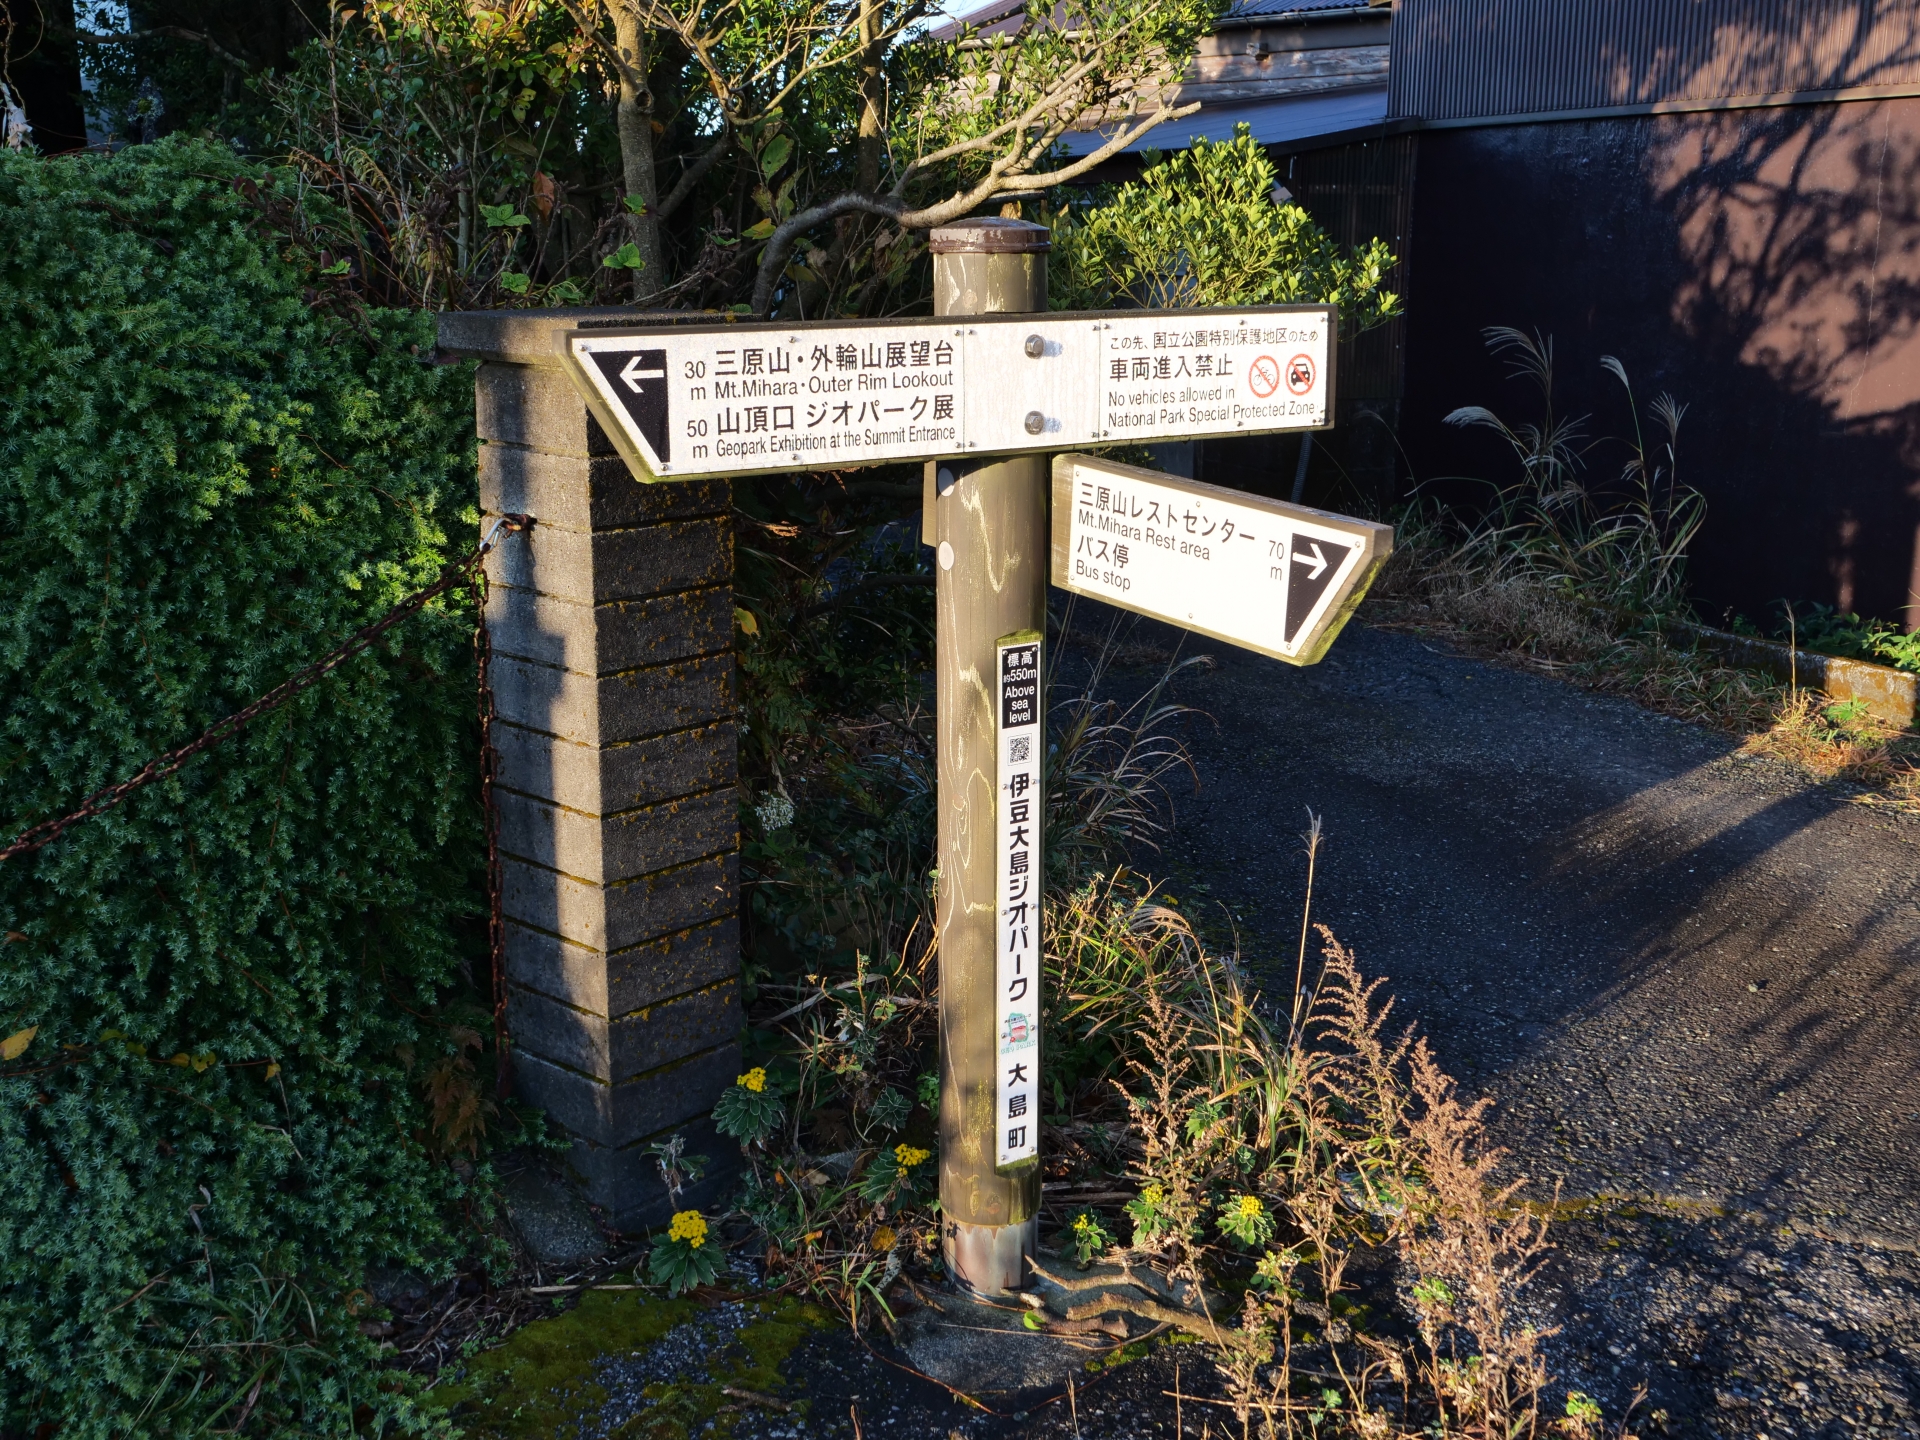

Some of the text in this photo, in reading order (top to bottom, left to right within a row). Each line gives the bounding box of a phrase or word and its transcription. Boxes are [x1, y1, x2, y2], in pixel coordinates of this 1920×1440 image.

[715, 340, 954, 376] 三原山・外輪山展望台
[1109, 353, 1233, 382] 車両進入禁止
[685, 361, 706, 379] 30
[858, 373, 887, 391] Rim
[892, 371, 953, 389] Lookout
[690, 386, 706, 400] m
[1109, 386, 1235, 407] No vehicles allowed in
[1108, 400, 1315, 428] National Park Special Protected Zone
[687, 419, 708, 437] 50
[692, 444, 708, 459] m
[716, 425, 955, 458] Geopark Exhibition at the Summit Entrance
[1079, 482, 1255, 543] 三原山レストセンター
[1078, 509, 1210, 561] Mt.Mihara Rest area
[1077, 535, 1129, 569] バス停
[1268, 540, 1285, 559] 70
[1076, 560, 1131, 592] Bus stop
[1270, 566, 1282, 581] m
[1007, 651, 1033, 667] 標高
[1005, 685, 1035, 699] Above
[1011, 699, 1029, 710] sea
[1009, 709, 1031, 723] level
[1009, 772, 1030, 1002] 伊豆大島ジオパーク
[1008, 1063, 1028, 1149] 大島町
